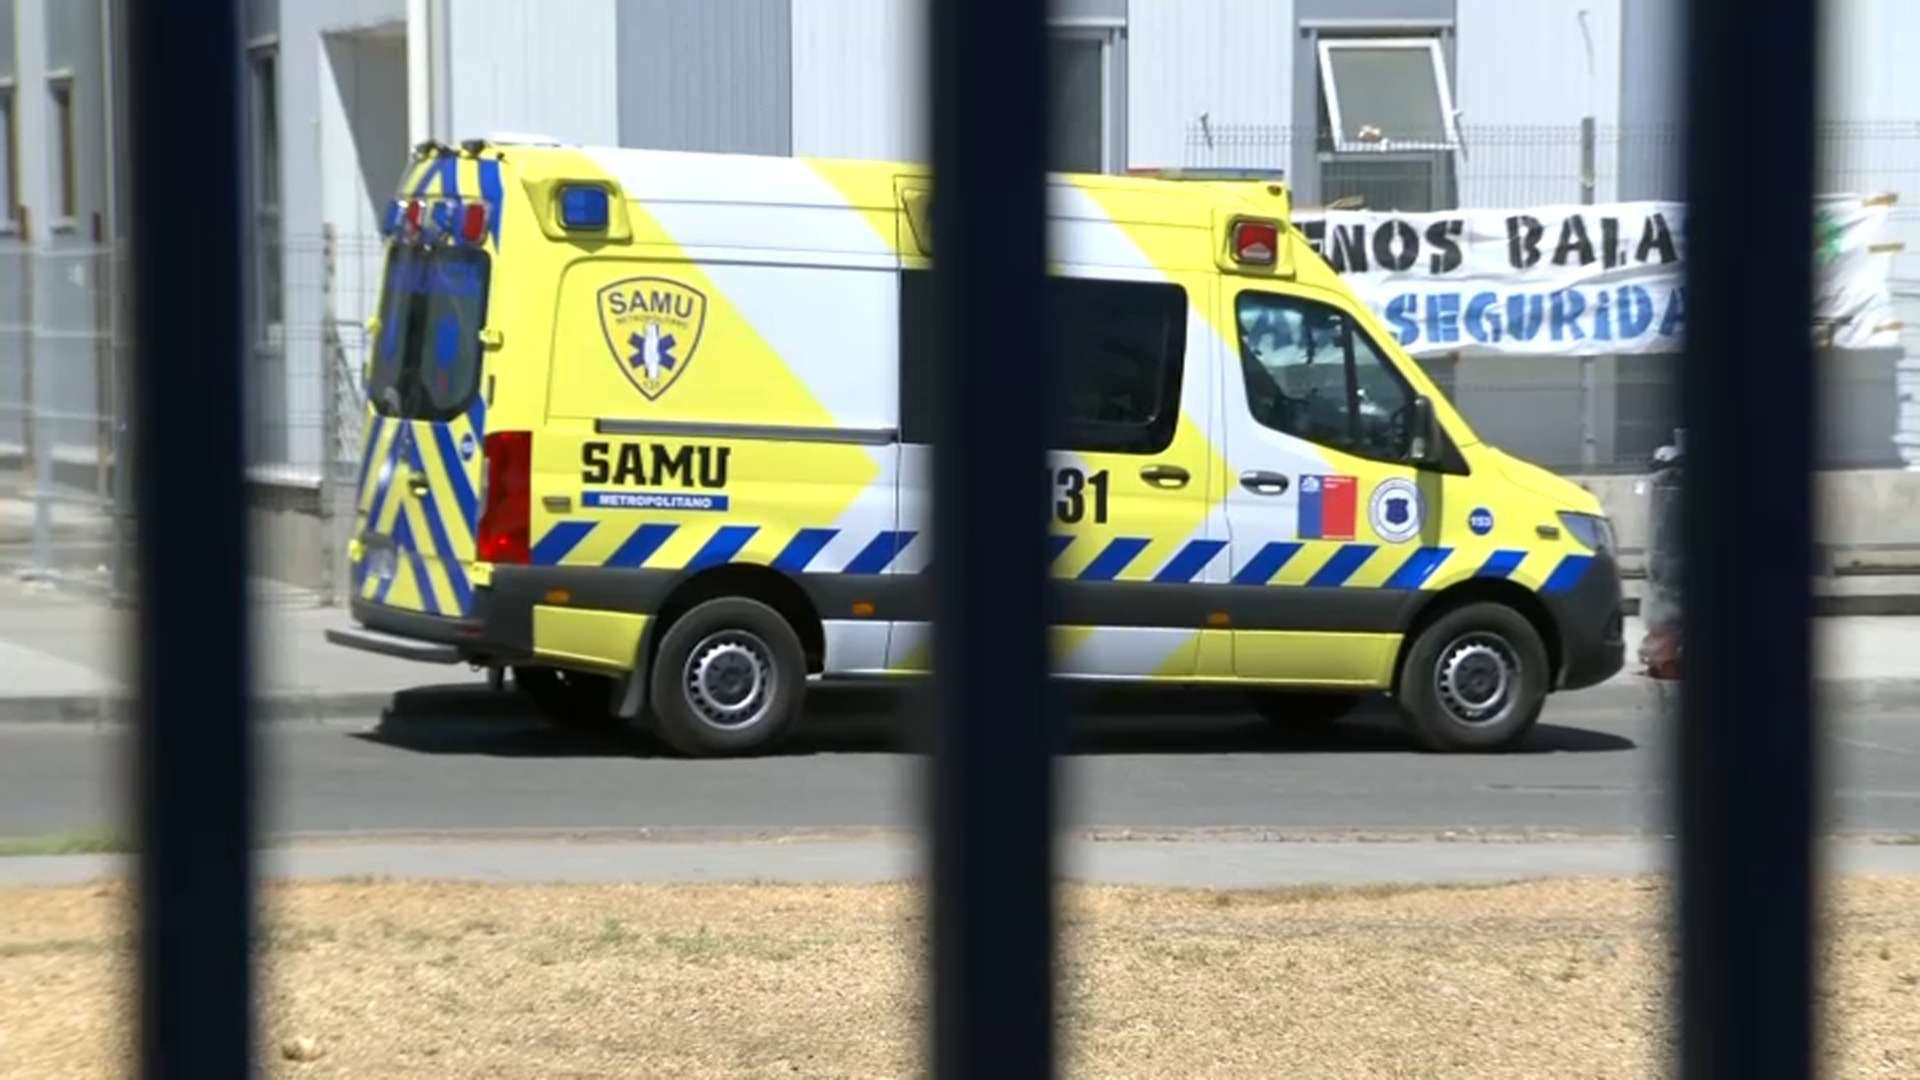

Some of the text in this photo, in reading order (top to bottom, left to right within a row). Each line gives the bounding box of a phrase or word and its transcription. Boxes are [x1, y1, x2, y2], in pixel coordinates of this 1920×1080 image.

[608, 289, 693, 318] SAMU
[582, 441, 731, 489] SAMU
[598, 494, 713, 509] METROPOLITANO
